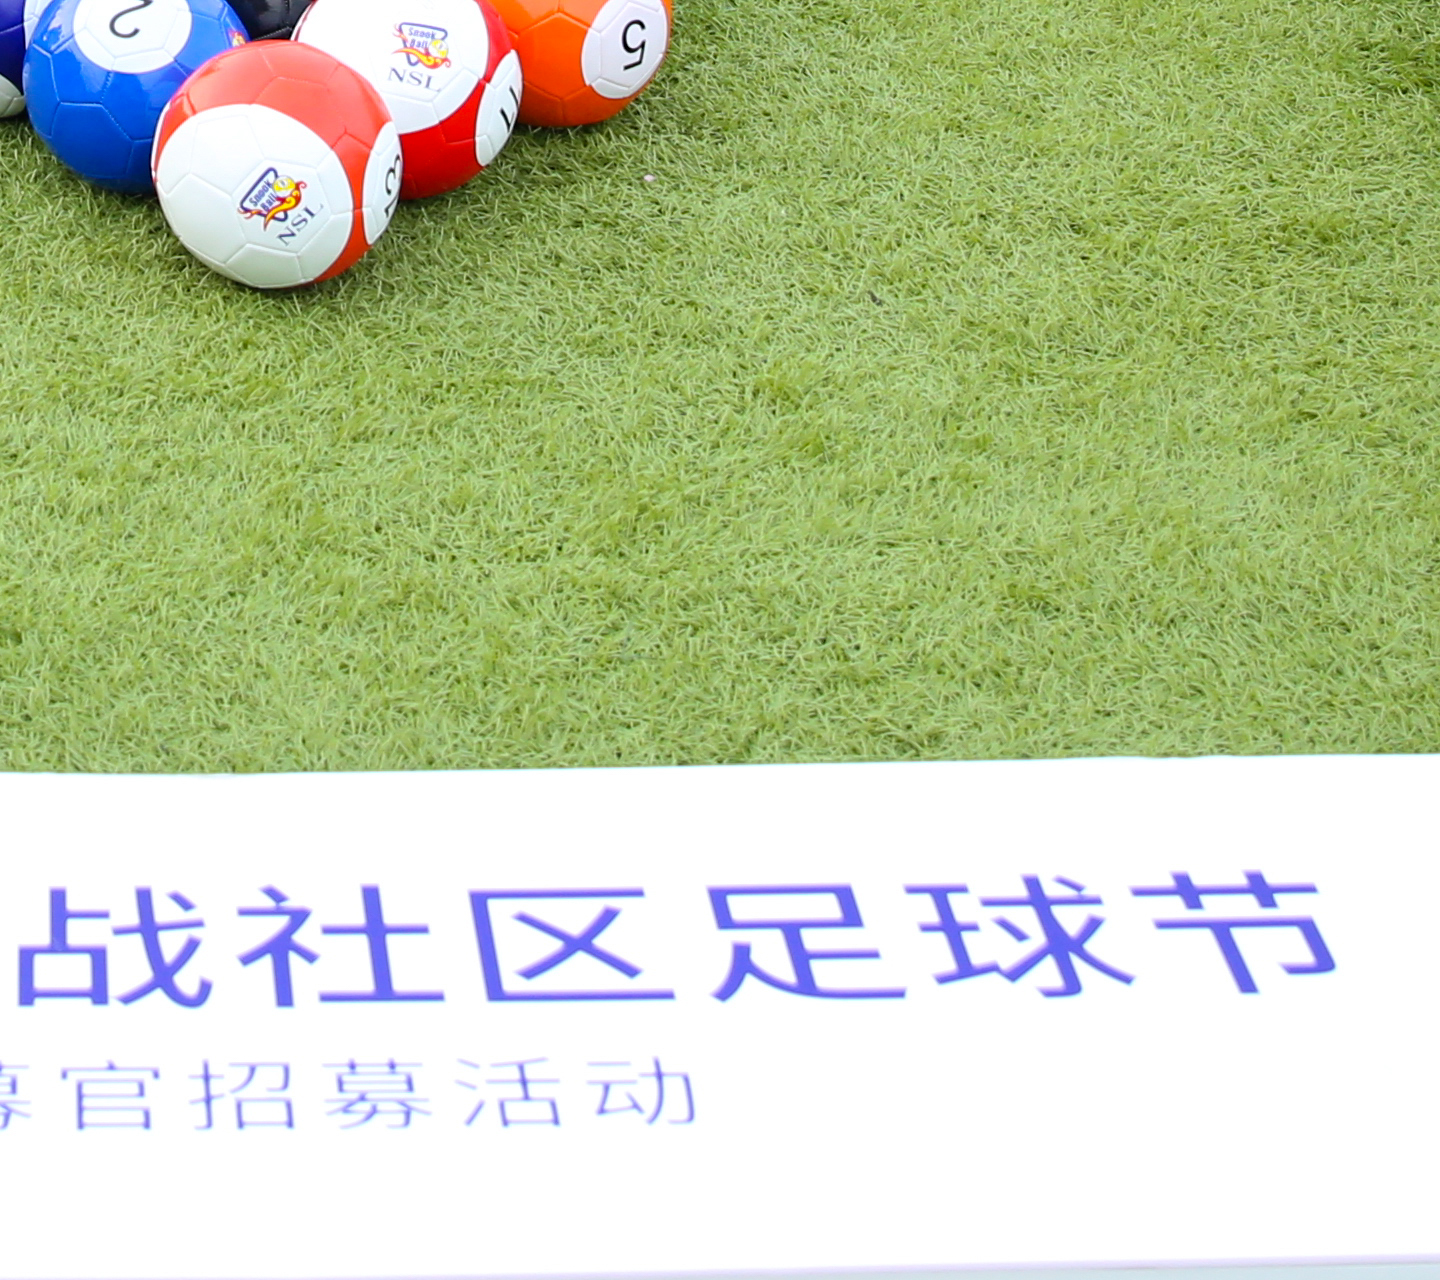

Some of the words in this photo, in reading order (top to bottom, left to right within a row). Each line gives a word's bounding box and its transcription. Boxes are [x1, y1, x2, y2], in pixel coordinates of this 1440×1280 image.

[620, 18, 648, 71] 5
[387, 66, 442, 93] NSL
[248, 177, 273, 208] Snook
[383, 153, 402, 220] 13
[276, 203, 325, 248] NSL
